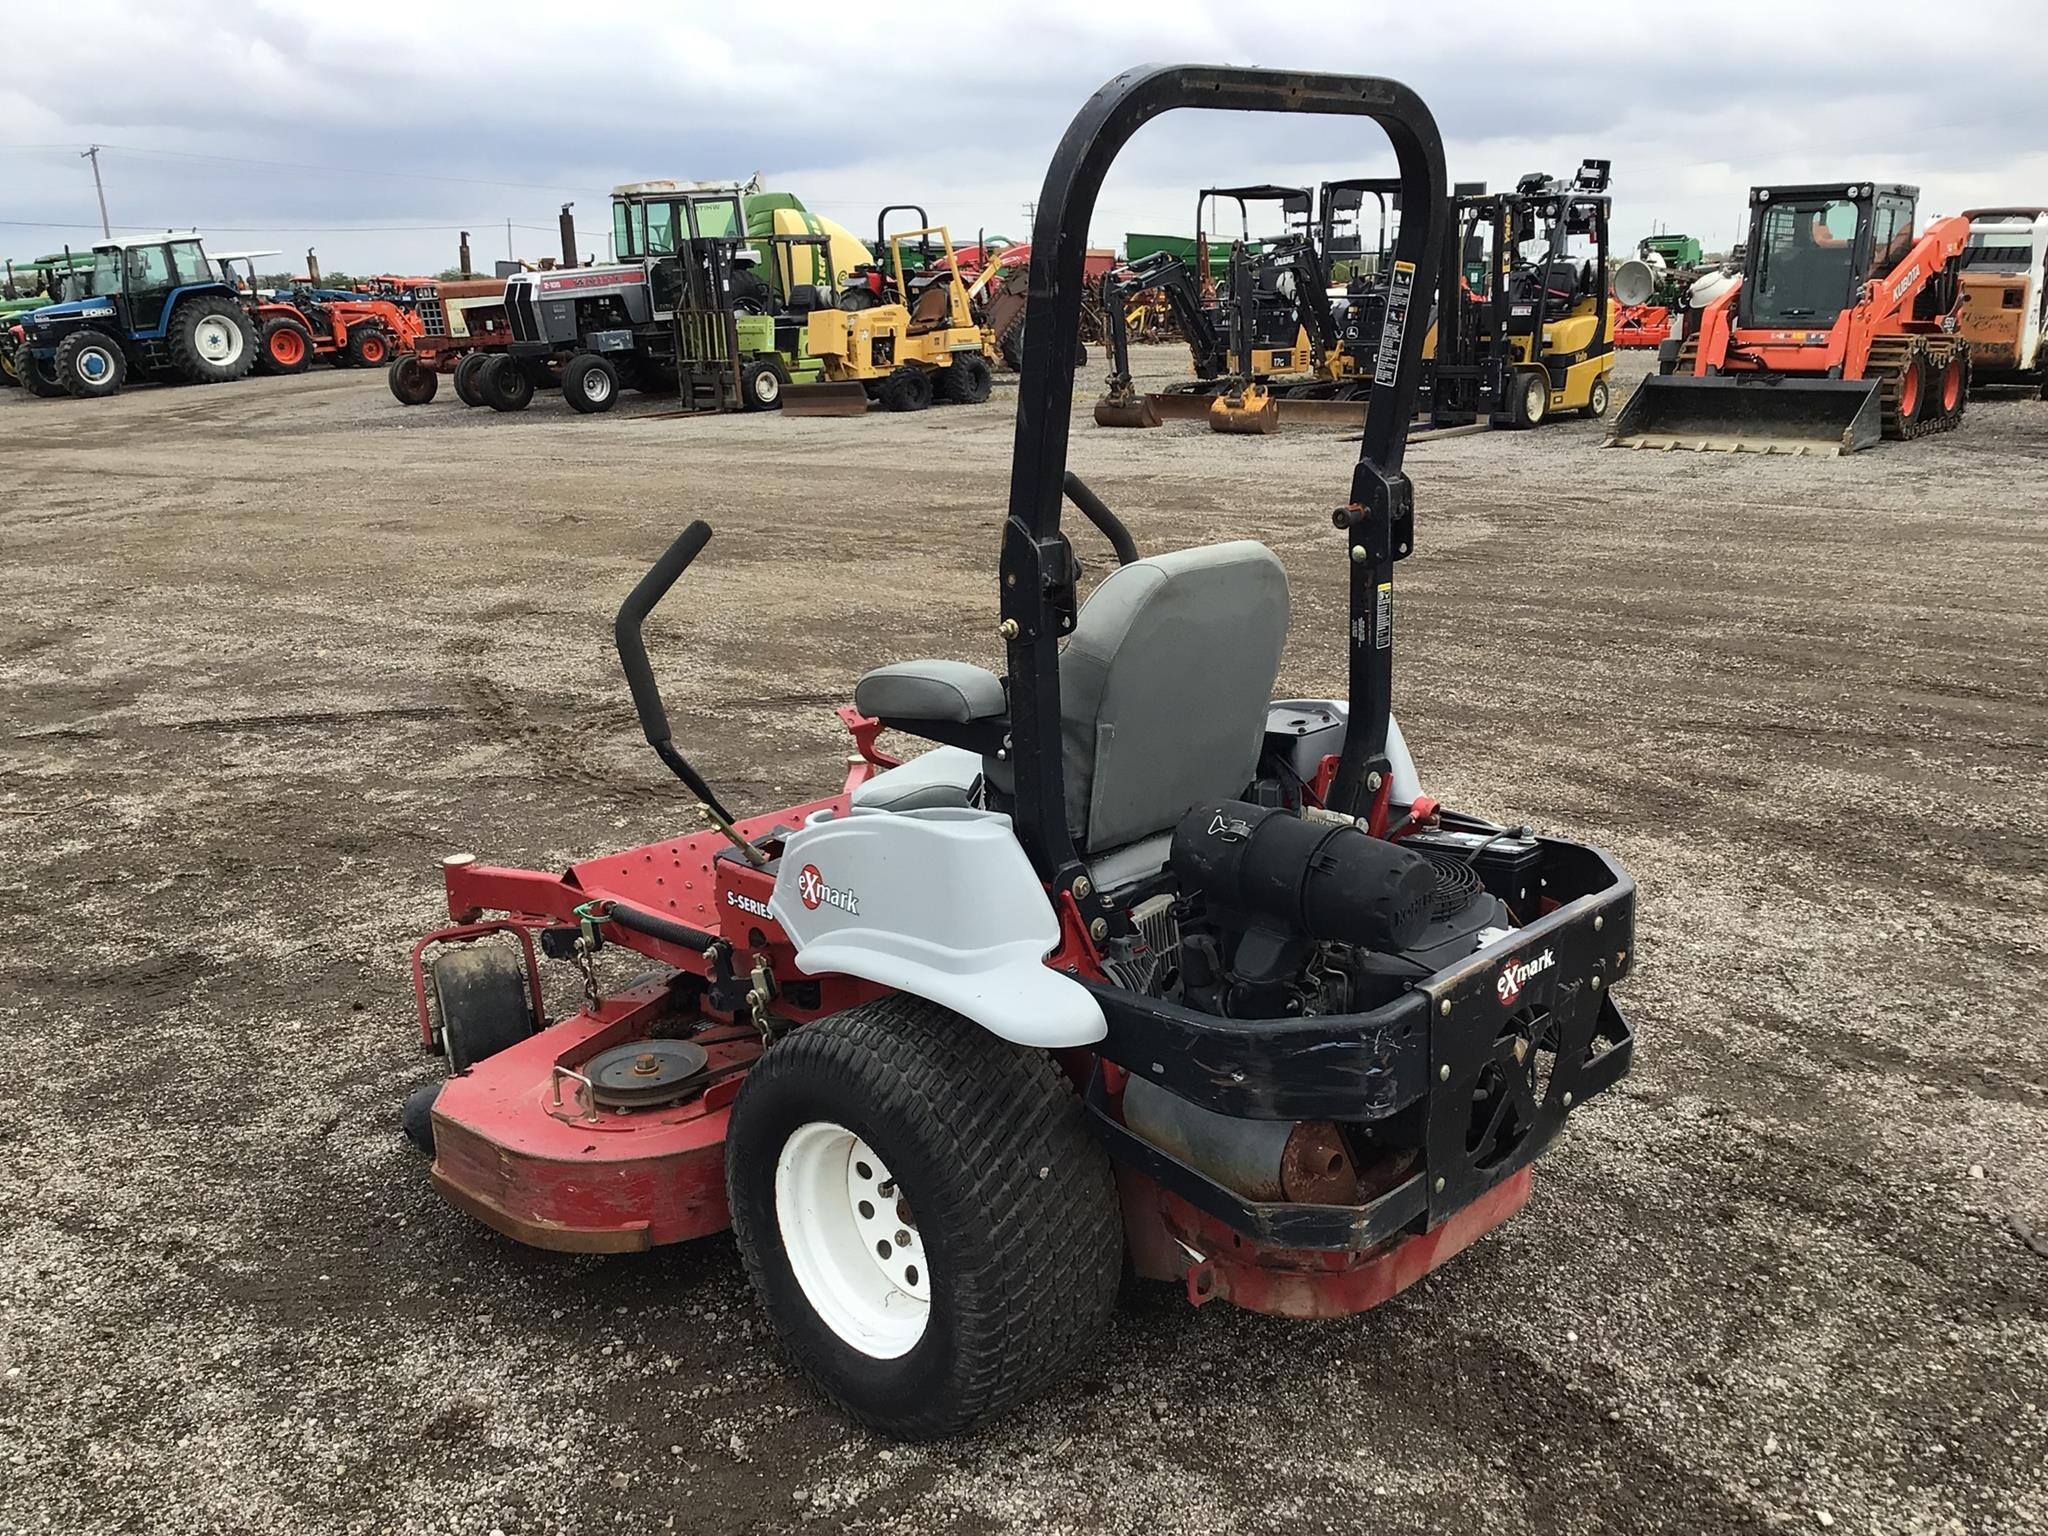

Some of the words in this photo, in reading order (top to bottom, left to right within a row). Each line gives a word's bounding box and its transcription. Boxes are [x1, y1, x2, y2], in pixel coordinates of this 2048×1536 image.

[1893, 264, 1920, 302] KUBOTA
[82, 307, 113, 317] FORD
[727, 891, 774, 920] S-SERIES
